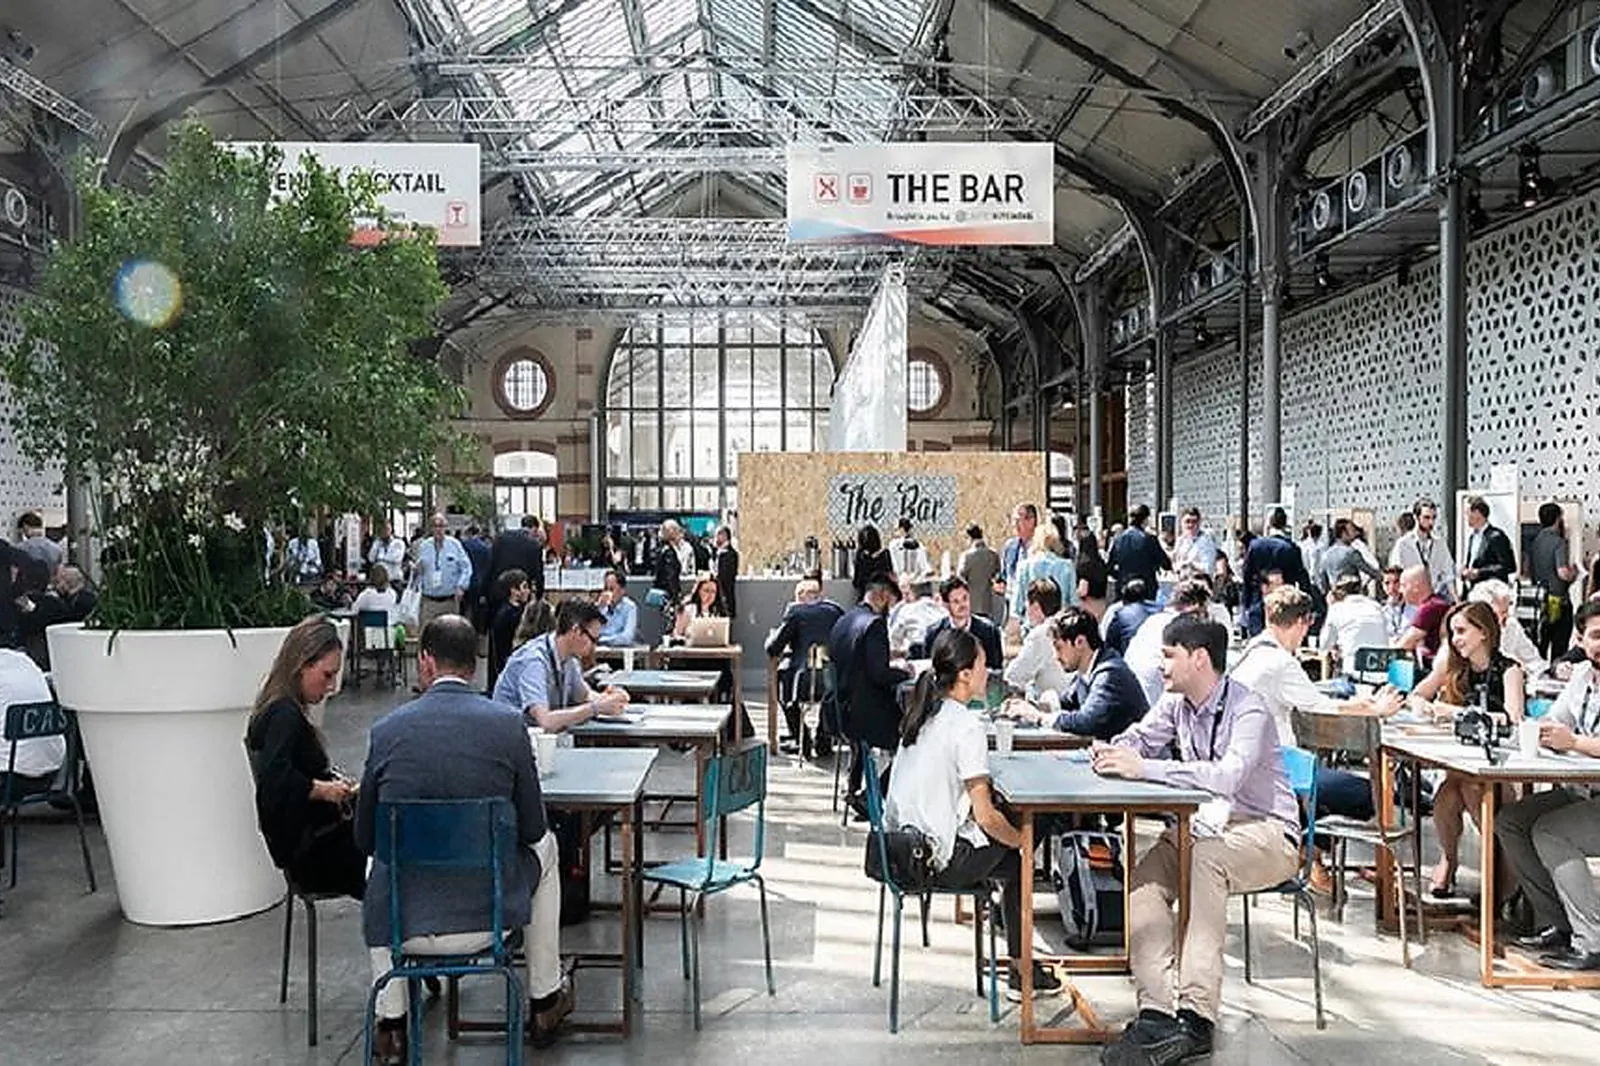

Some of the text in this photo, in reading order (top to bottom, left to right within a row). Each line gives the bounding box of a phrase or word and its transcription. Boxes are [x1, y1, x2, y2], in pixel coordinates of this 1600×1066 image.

[887, 173, 1024, 204] THE BAR
[840, 480, 944, 525] The Bar
